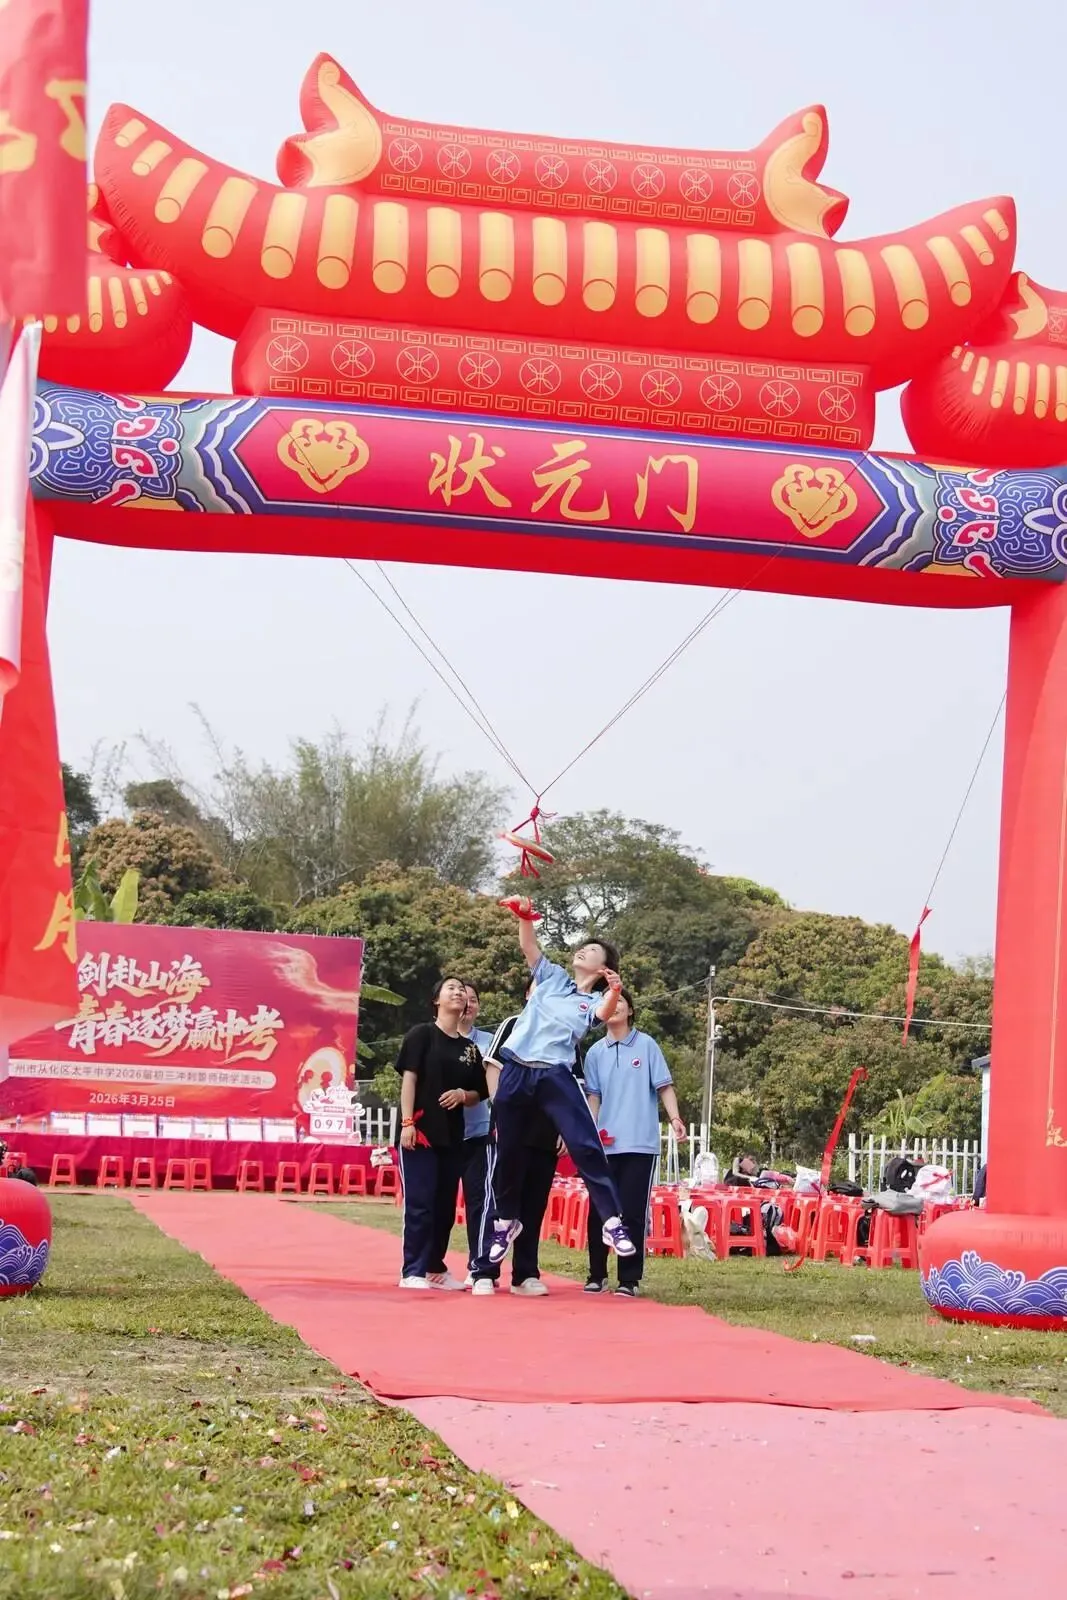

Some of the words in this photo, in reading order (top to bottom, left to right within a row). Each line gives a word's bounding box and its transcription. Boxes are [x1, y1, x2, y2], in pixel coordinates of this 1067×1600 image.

[429, 433, 698, 532] 状元门
[55, 994, 284, 1064] 青春逐梦赢中考
[89, 1091, 176, 1109] 2026年3月25日
[314, 1119, 345, 1130] 097
